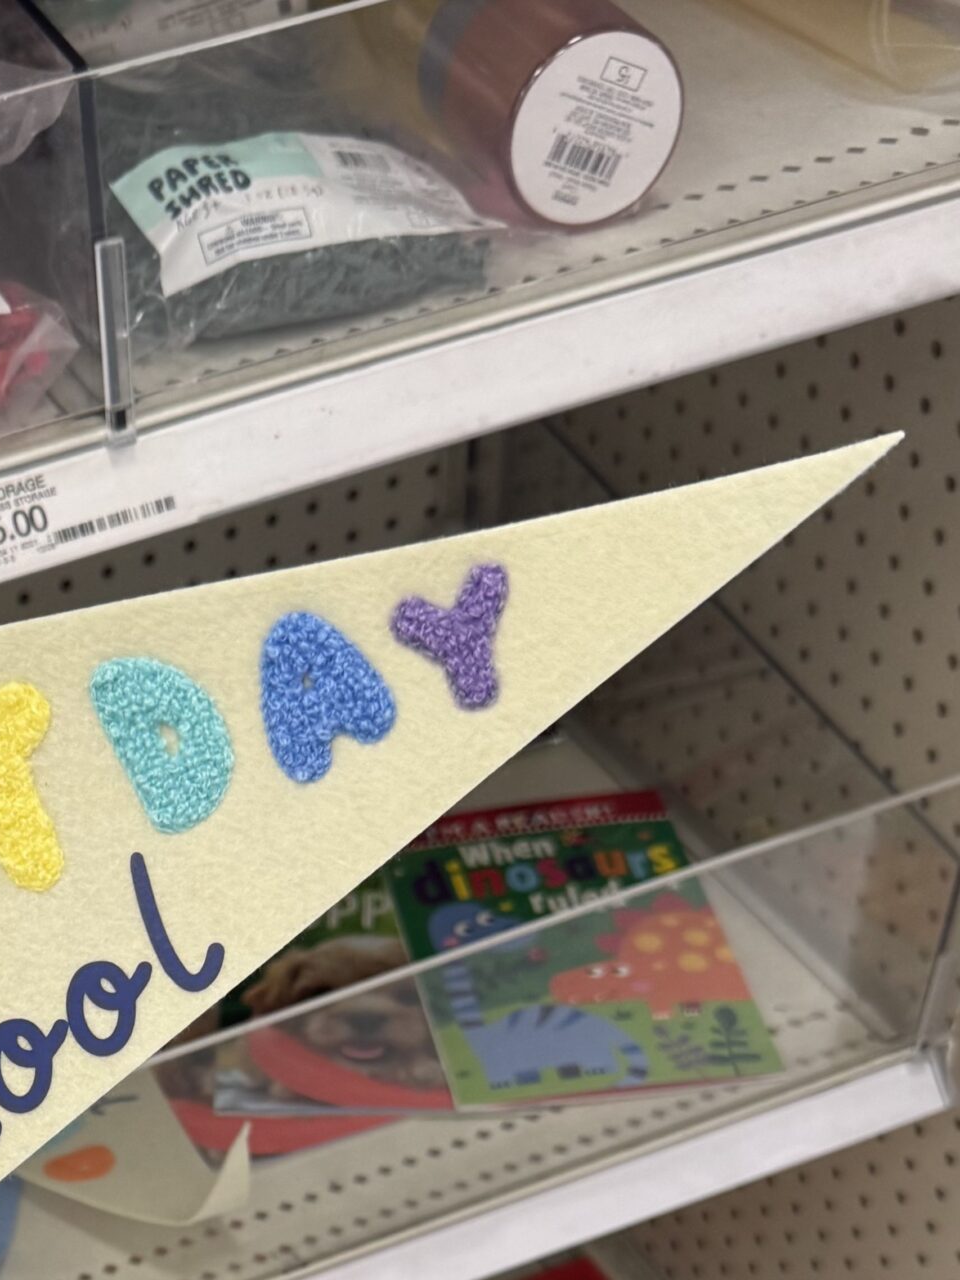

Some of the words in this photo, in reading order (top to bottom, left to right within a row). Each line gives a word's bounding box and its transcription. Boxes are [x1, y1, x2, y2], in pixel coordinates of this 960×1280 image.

[148, 154, 239, 202] PAPER
[165, 169, 252, 221] SHRED
[88, 564, 511, 834] DAY
[413, 844, 680, 905] dinosaurs
[456, 836, 555, 868] When
